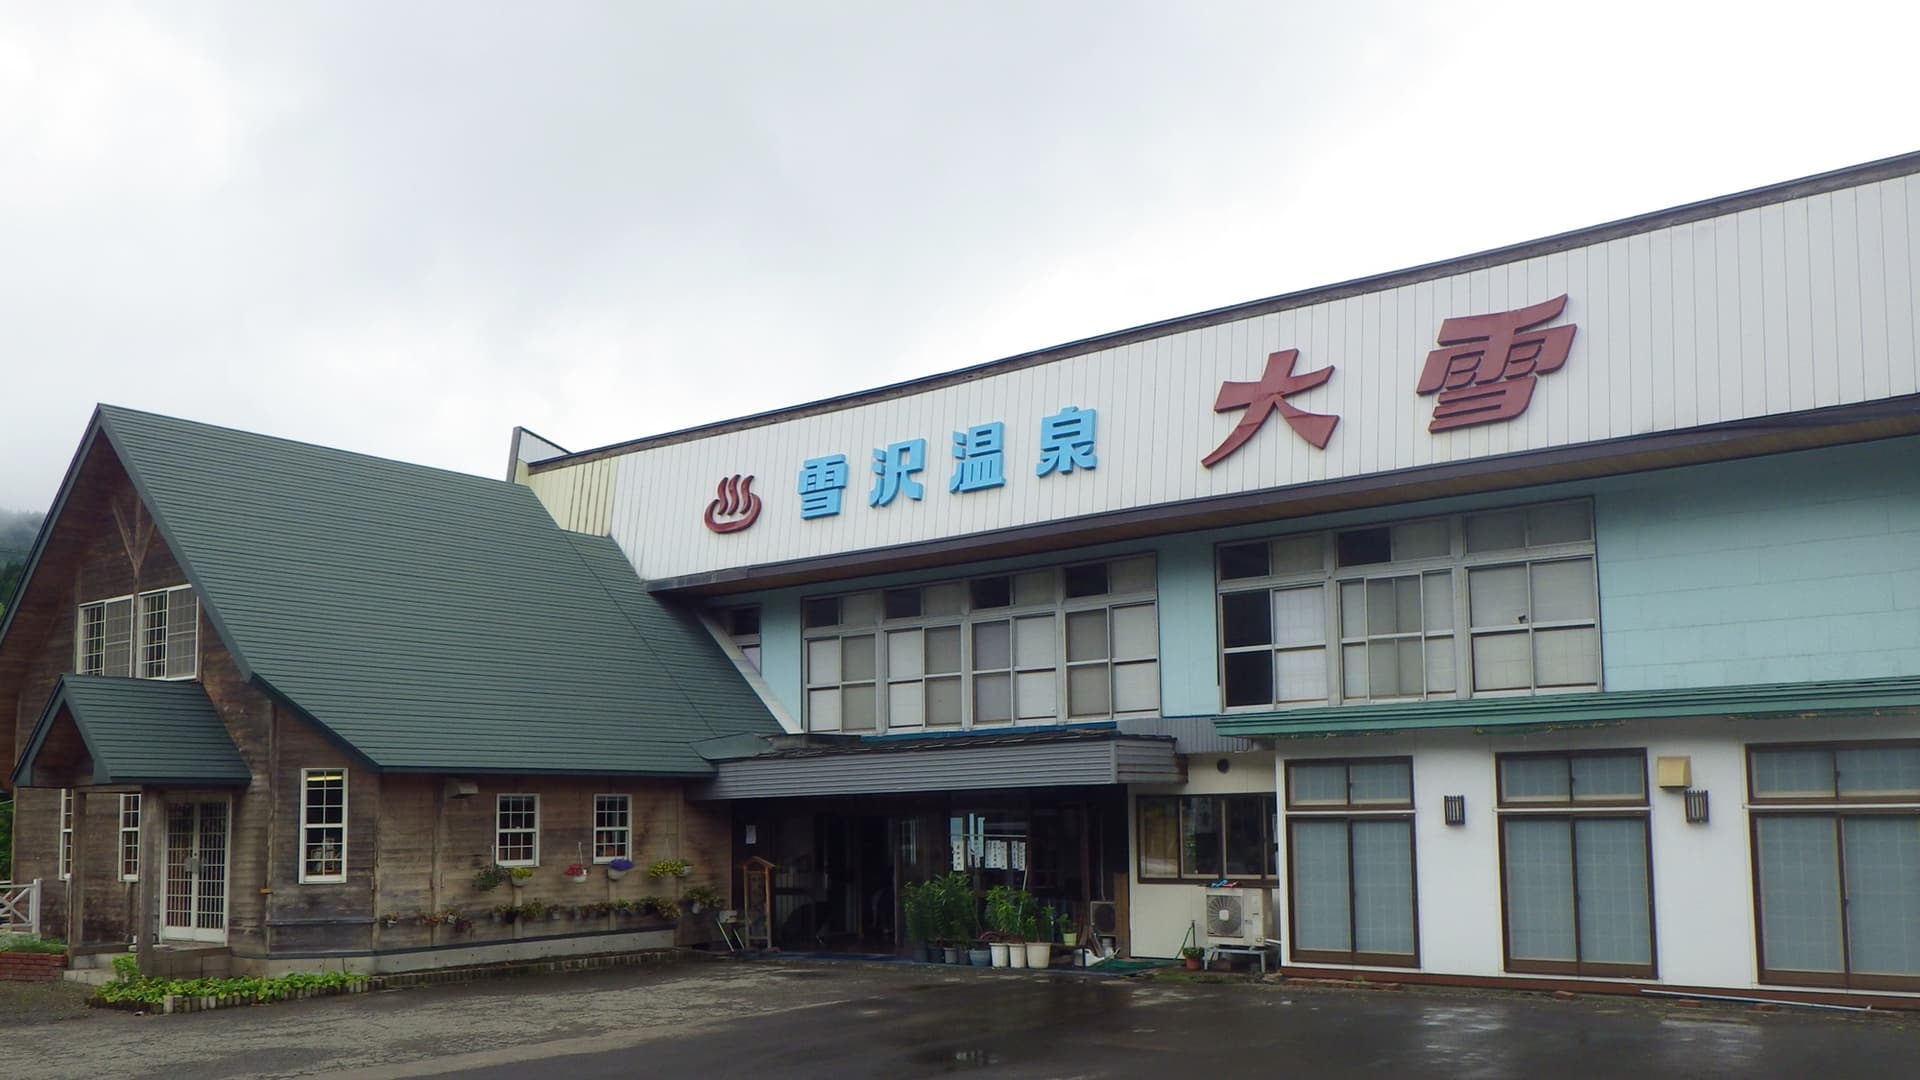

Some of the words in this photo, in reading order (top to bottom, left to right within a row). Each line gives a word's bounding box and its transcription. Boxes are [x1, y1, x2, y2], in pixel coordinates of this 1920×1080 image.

[797, 406, 1099, 520] 雪沢温泉
[1202, 294, 1576, 468] 大雪
